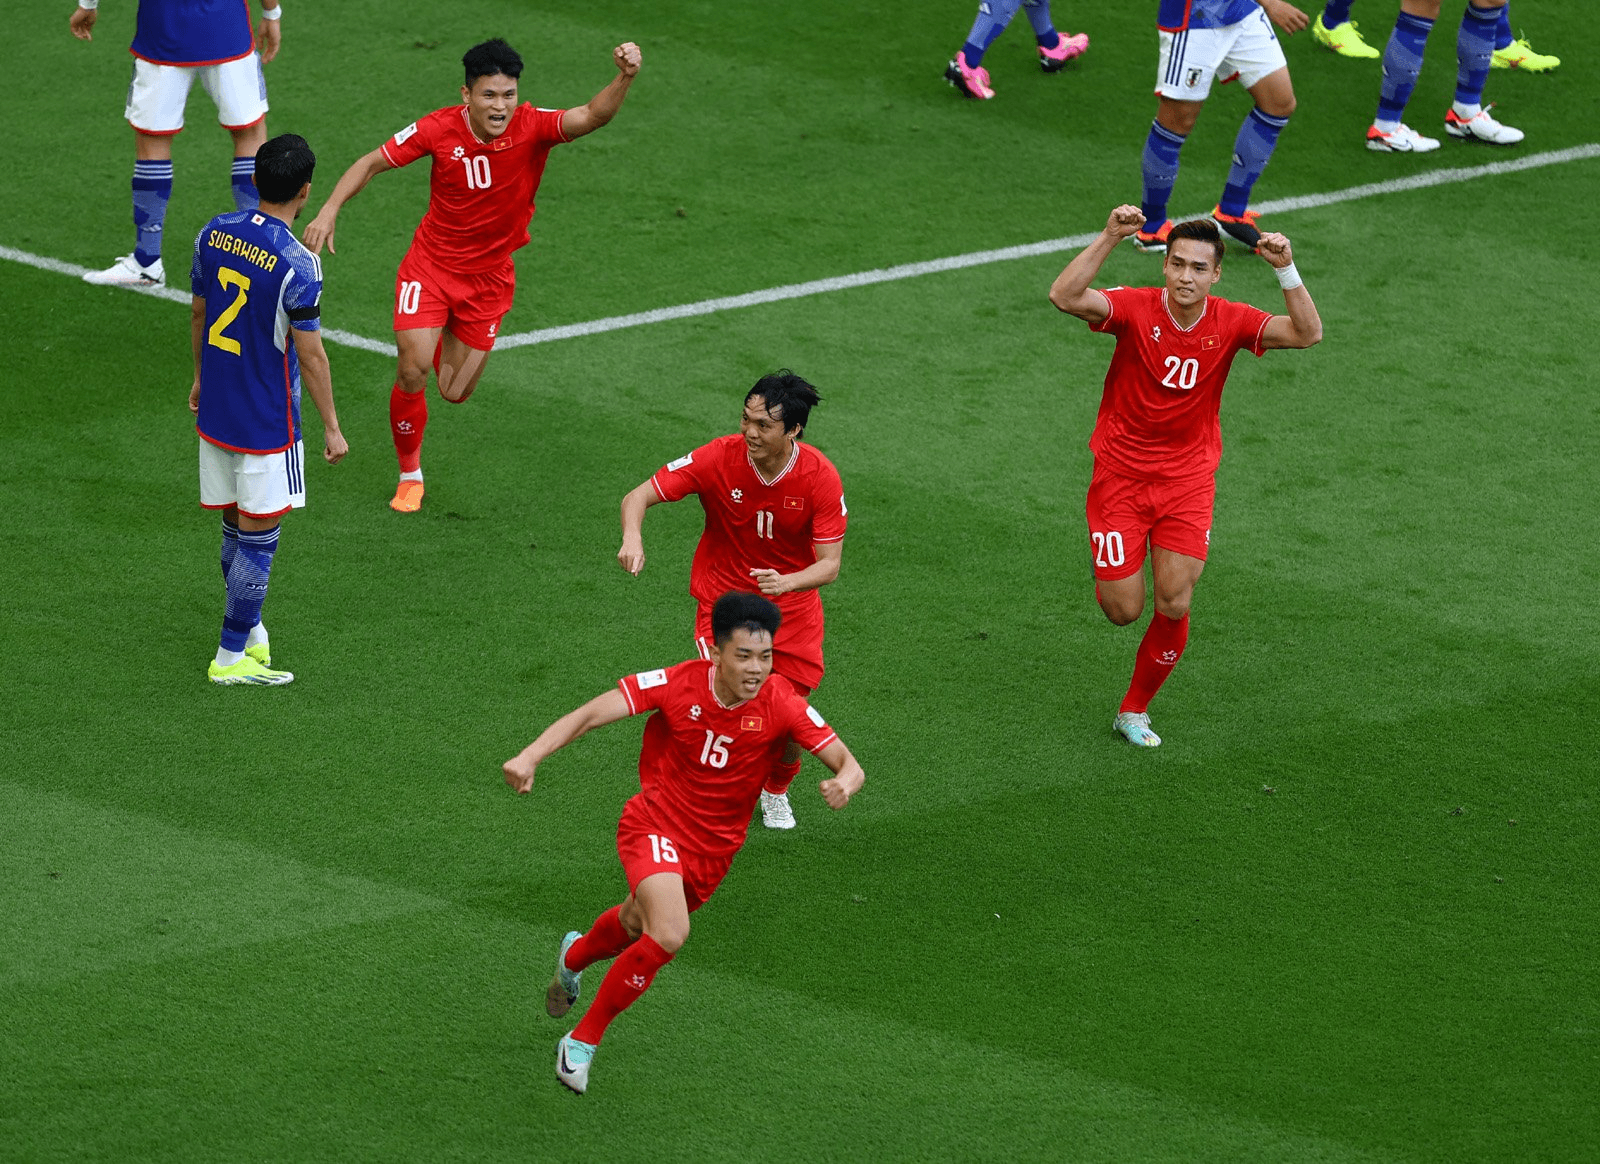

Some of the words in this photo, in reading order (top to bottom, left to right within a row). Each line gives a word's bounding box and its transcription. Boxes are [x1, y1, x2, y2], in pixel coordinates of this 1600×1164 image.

[462, 155, 492, 190] 10
[208, 229, 278, 272] SUGAWARA
[208, 266, 251, 357] 2
[398, 281, 422, 315] 10
[1161, 355, 1199, 390] 20
[756, 510, 774, 539] 11
[1092, 531, 1125, 568] 20
[700, 729, 734, 769] 15
[647, 834, 679, 863] 15
